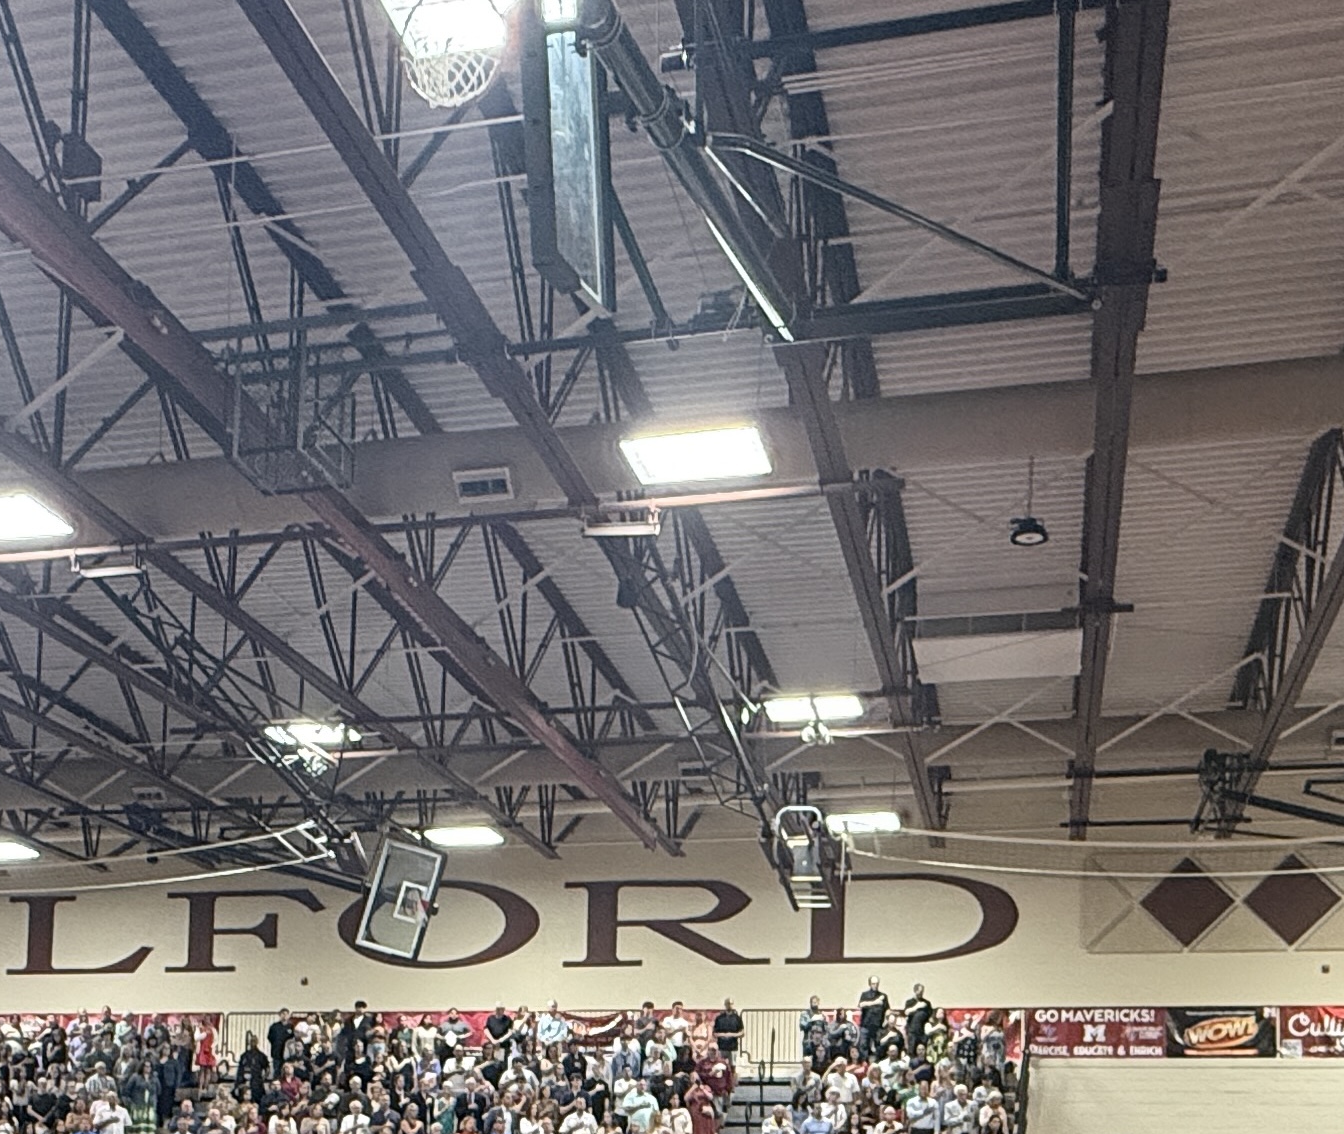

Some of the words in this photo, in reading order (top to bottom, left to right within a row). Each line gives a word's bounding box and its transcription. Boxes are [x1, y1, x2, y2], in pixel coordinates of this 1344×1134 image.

[1035, 1009, 1058, 1023] GO
[1061, 1009, 1155, 1022] MAVERICKS!
[1083, 1024, 1106, 1042] M
[1117, 1045, 1126, 1055] &
